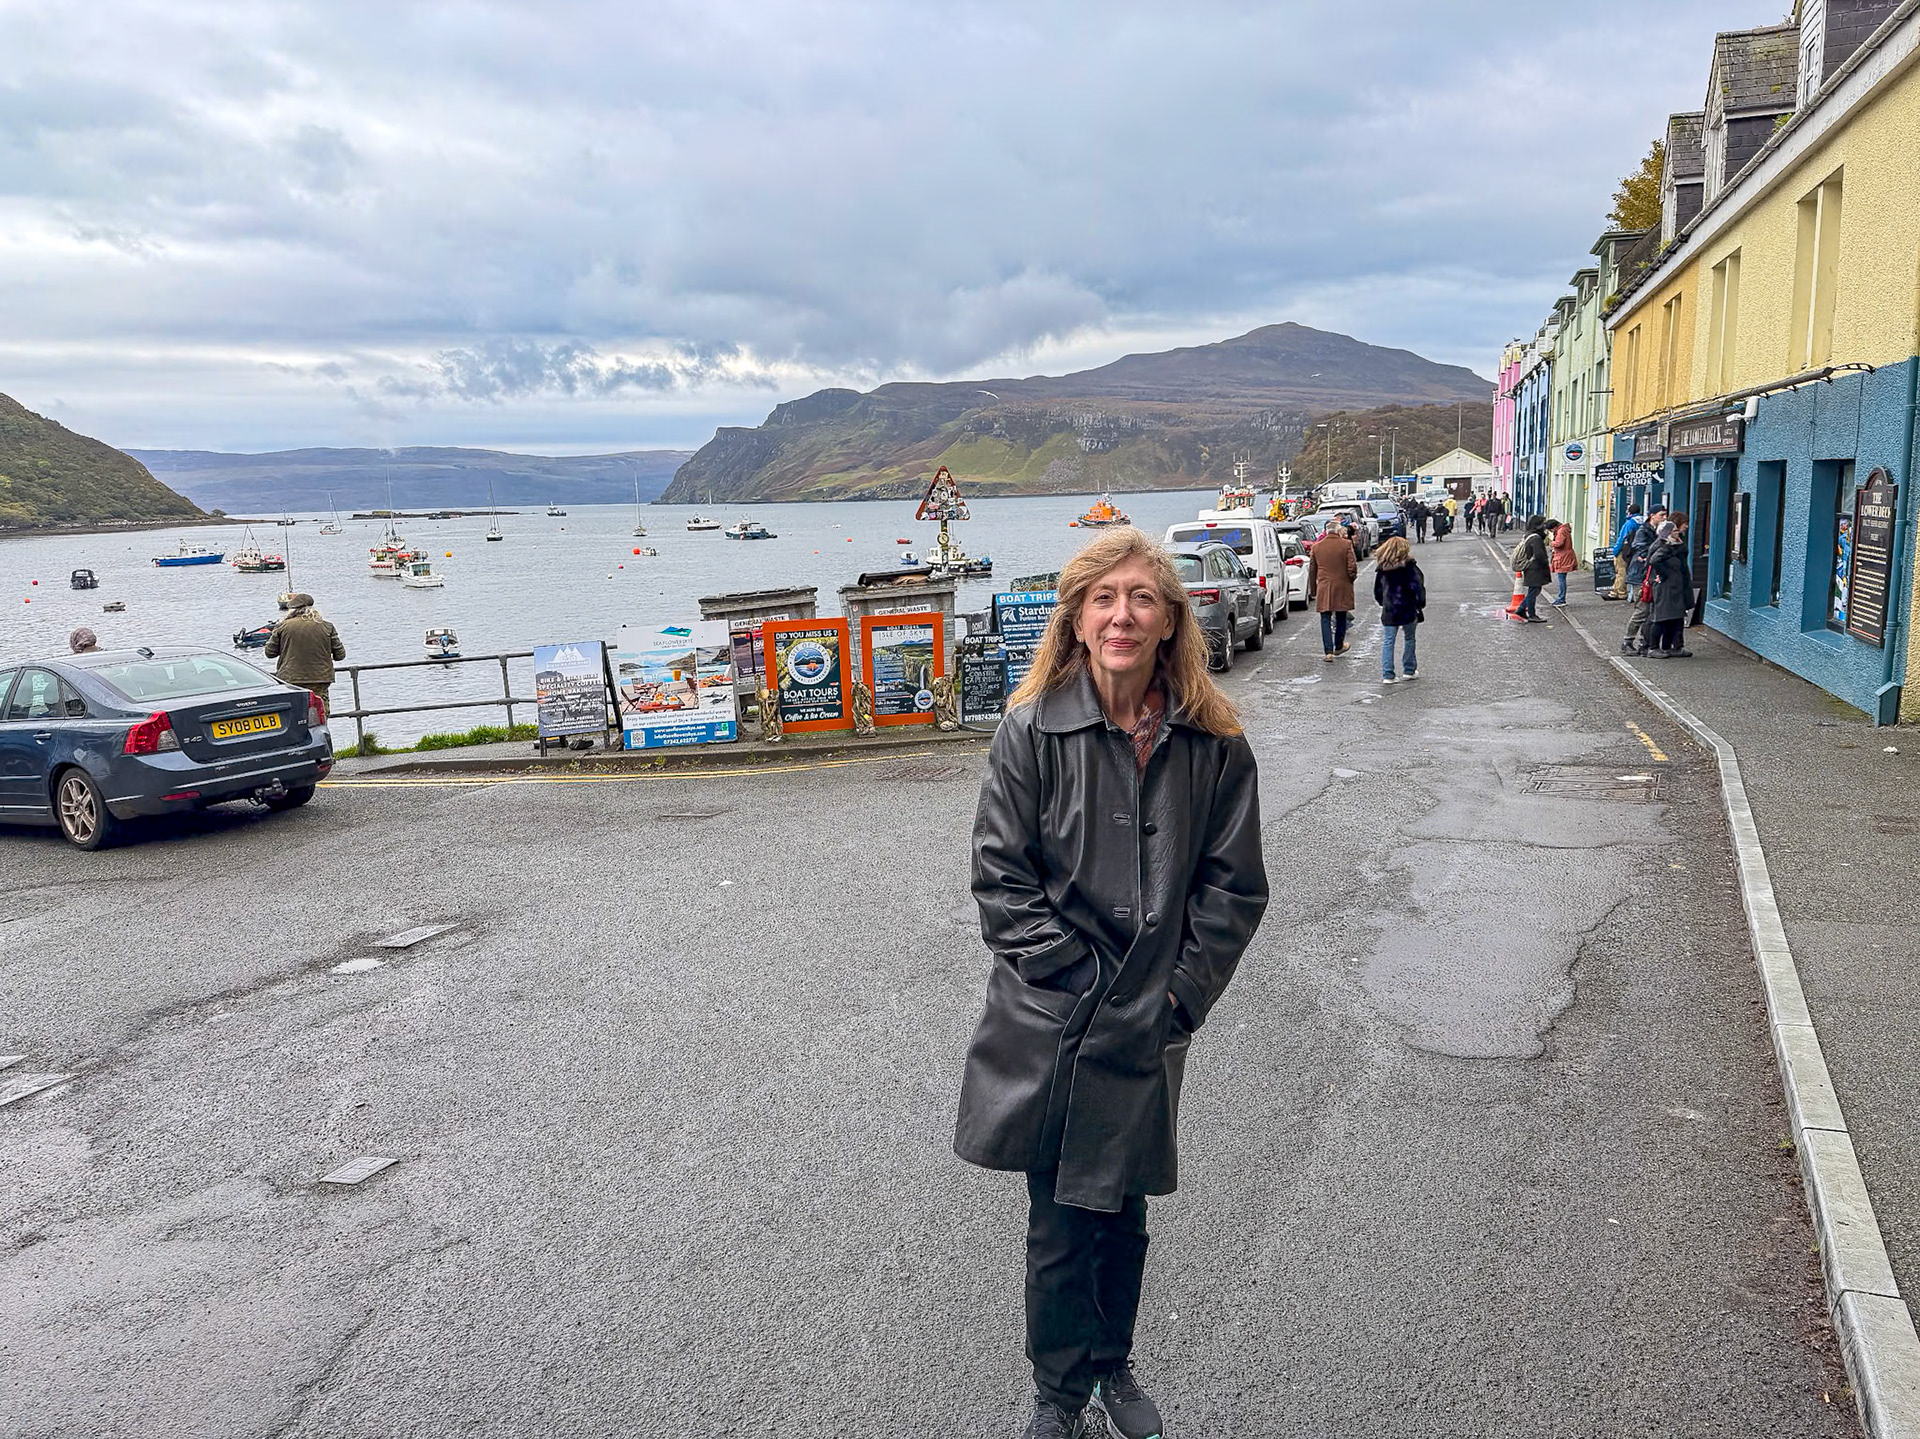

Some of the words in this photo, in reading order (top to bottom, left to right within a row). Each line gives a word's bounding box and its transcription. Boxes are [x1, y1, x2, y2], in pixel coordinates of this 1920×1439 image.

[1623, 471, 1653, 480] ORDER
[1623, 478, 1653, 486] INSIDE
[1872, 492, 1883, 504] THE
[999, 594, 1027, 603] BOAT
[1029, 592, 1058, 602] TRIPS
[775, 631, 787, 640] DID
[789, 631, 804, 639] YOU
[805, 630, 822, 638] MISS
[964, 635, 984, 644] BOAT
[984, 635, 1004, 643] TRIPS
[783, 688, 808, 699] BOAT
[809, 687, 839, 697] TOURS
[784, 713, 803, 722] Coffee
[810, 712, 818, 720] Ice
[819, 711, 839, 719] Cream
[218, 721, 251, 735] SY08
[253, 717, 277, 729] OLB
